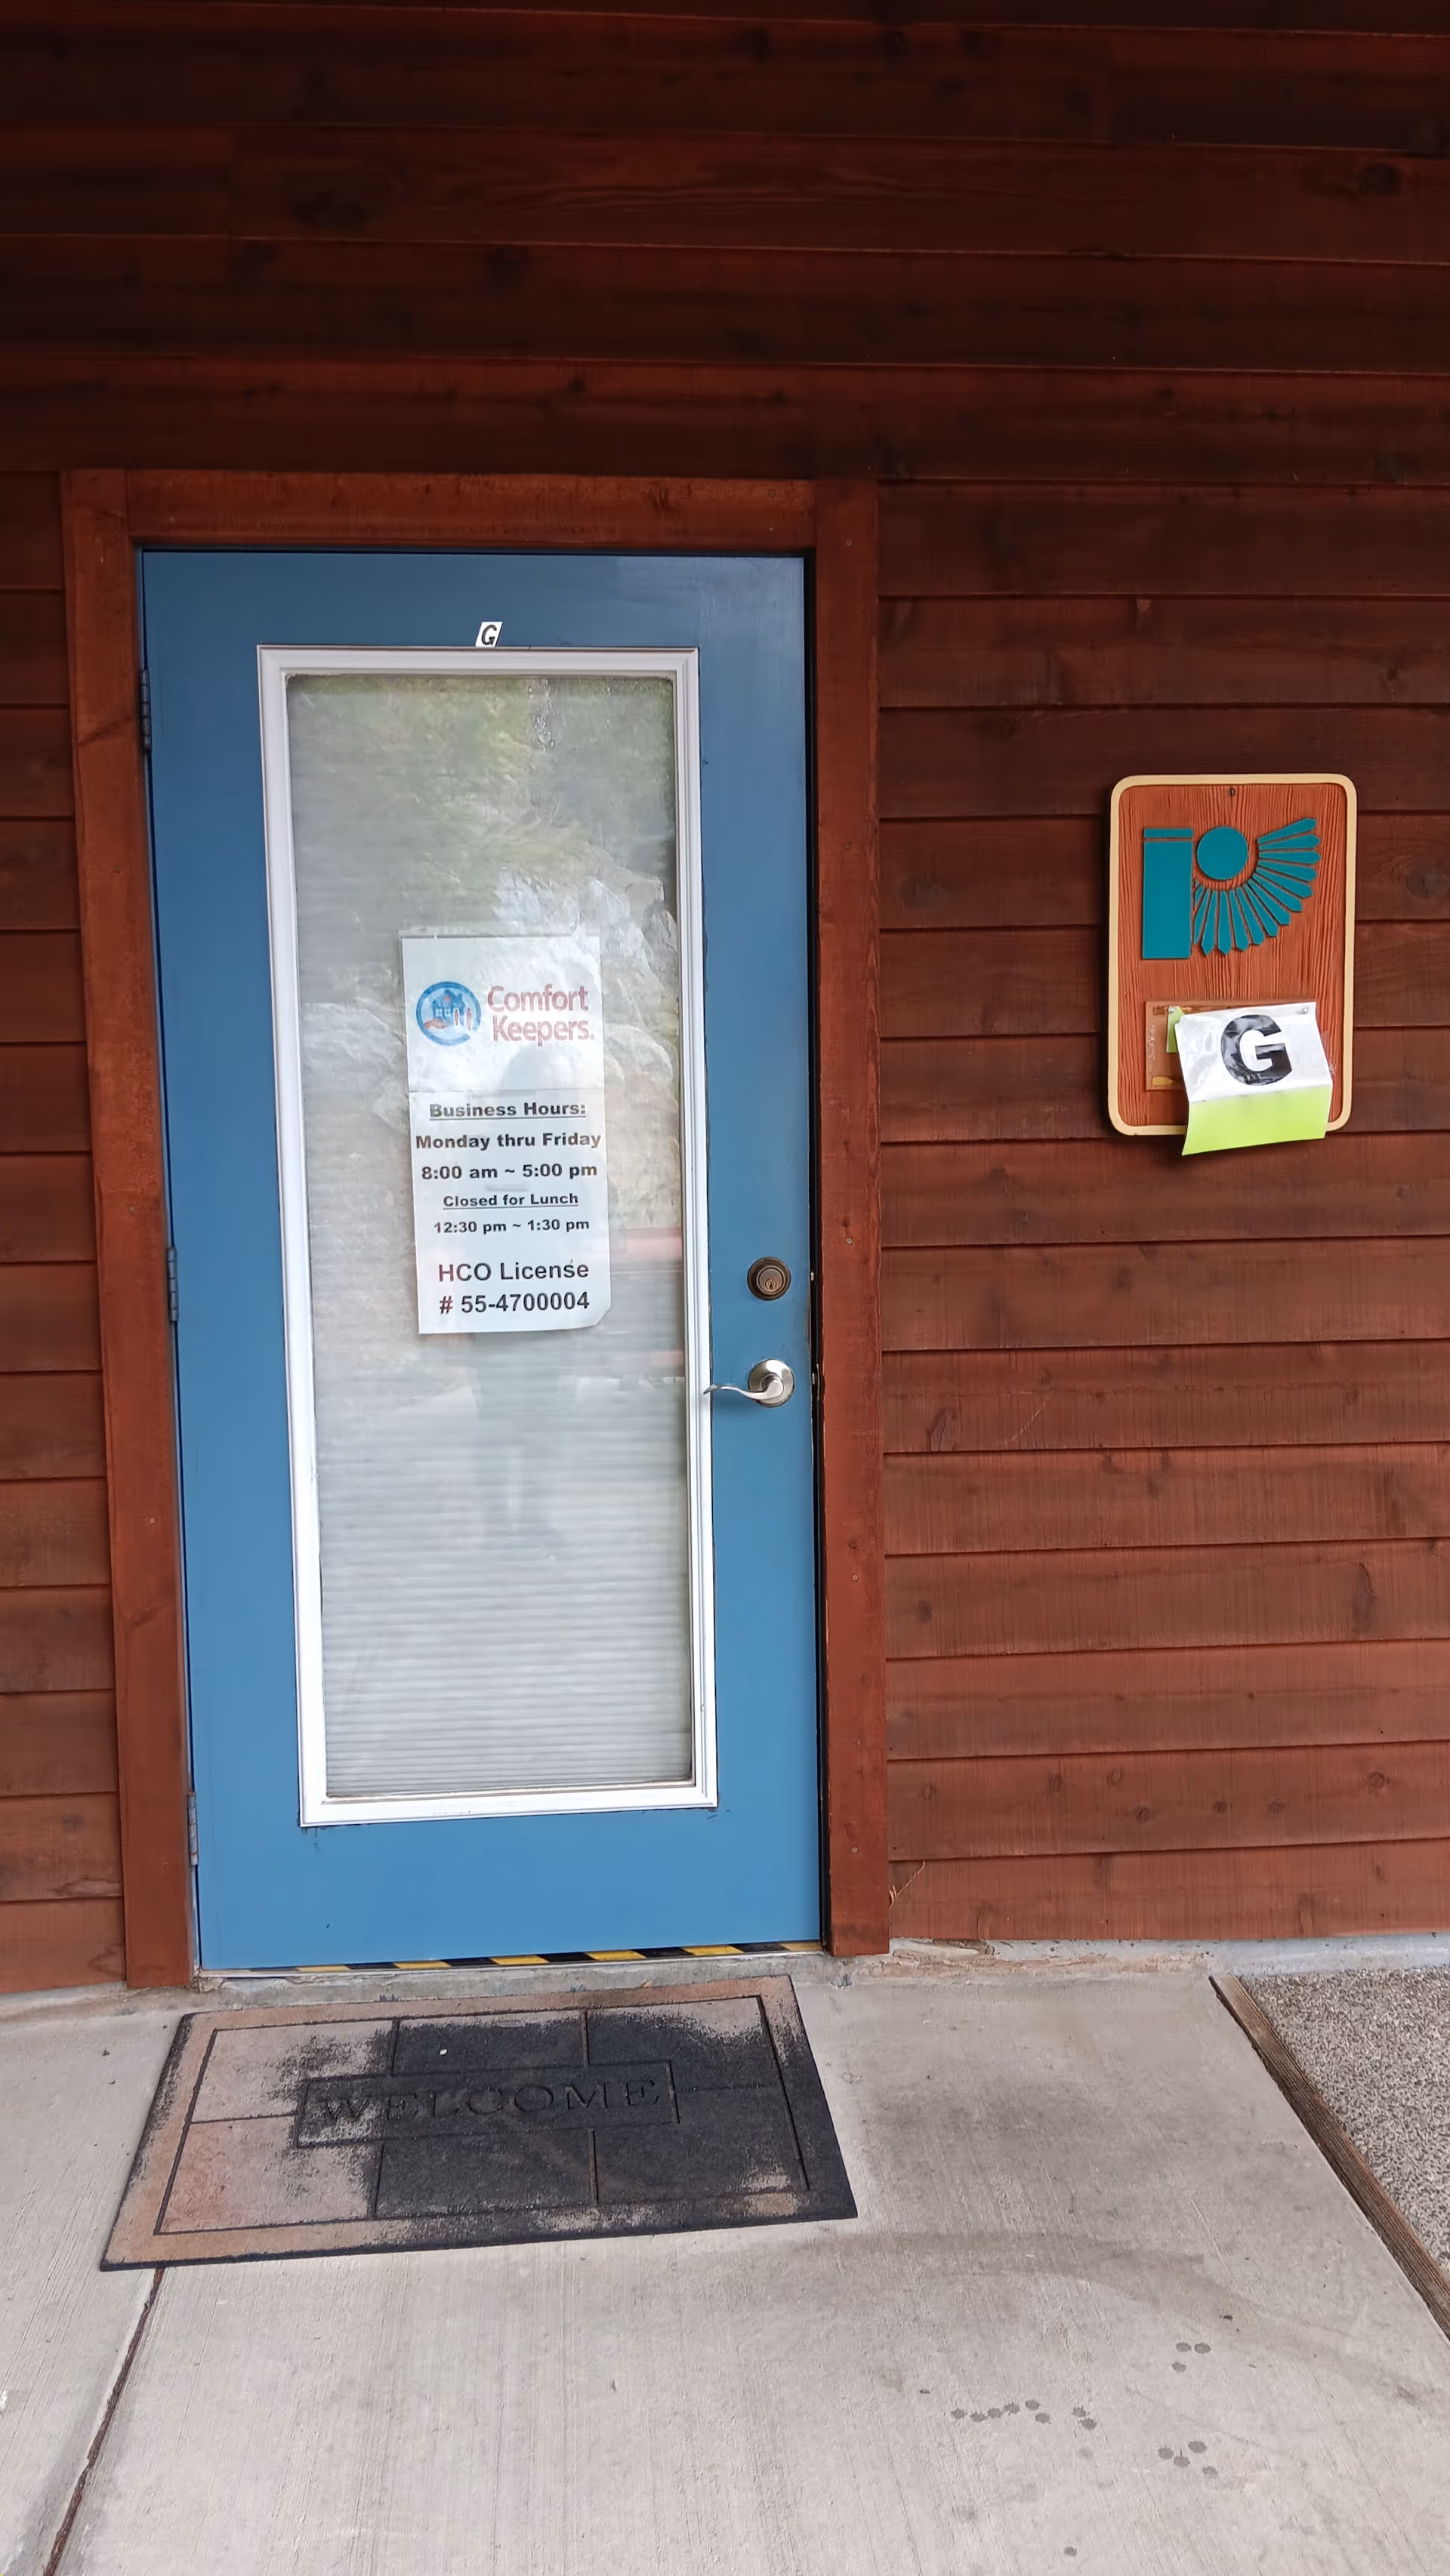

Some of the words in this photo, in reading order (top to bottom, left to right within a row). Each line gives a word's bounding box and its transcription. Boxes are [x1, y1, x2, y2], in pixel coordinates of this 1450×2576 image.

[481, 624, 497, 645] G
[487, 984, 588, 1012] Comfort
[1220, 1014, 1292, 1086] G
[430, 1103, 517, 1117] Business
[524, 1102, 586, 1115] Hours:
[416, 1135, 490, 1151] Monday
[497, 1134, 535, 1146] thru
[542, 1132, 601, 1148] Friday
[421, 1166, 462, 1179] 8:00
[469, 1167, 498, 1179] am
[523, 1163, 563, 1177] 5:00
[569, 1166, 597, 1179] pm
[443, 1195, 497, 1206] Closed
[503, 1194, 525, 1205] for
[531, 1193, 578, 1204] Lunch
[434, 1222, 477, 1234] 12:30
[483, 1223, 507, 1234] pm
[528, 1219, 560, 1231] 1:30
[566, 1221, 590, 1232] pm
[439, 1263, 492, 1282] HCO
[501, 1262, 589, 1280] License
[440, 1296, 453, 1314] #
[461, 1292, 590, 1314] 55-4700004
[319, 2079, 659, 2122] WELCOME
